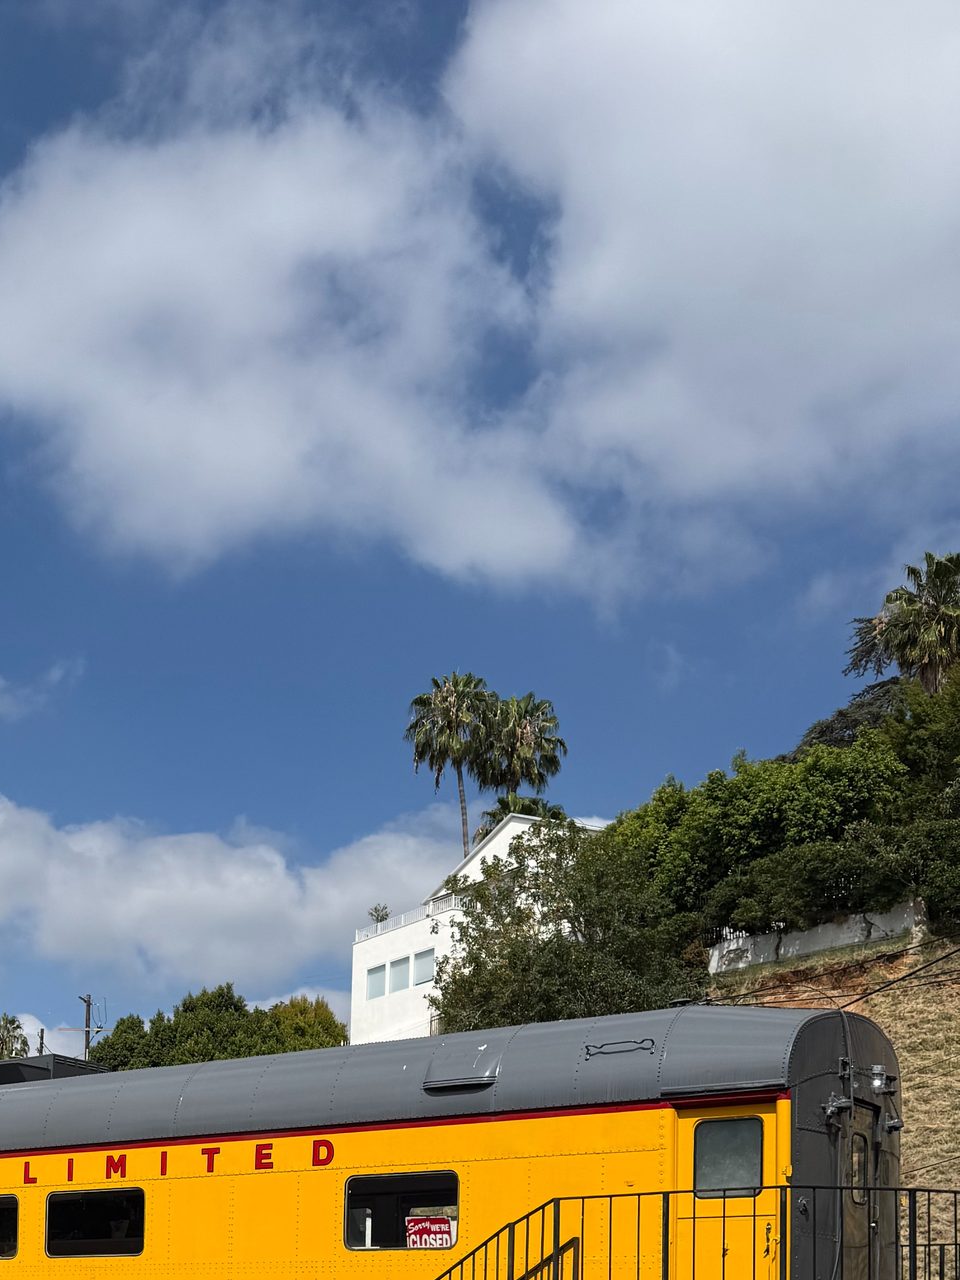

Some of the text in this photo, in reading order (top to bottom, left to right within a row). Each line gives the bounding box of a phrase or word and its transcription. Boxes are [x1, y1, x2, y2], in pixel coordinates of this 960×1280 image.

[23, 1138, 336, 1185] LIMITED
[408, 1221, 450, 1233] Sorry WE'RE
[409, 1233, 451, 1248] CLOSED
